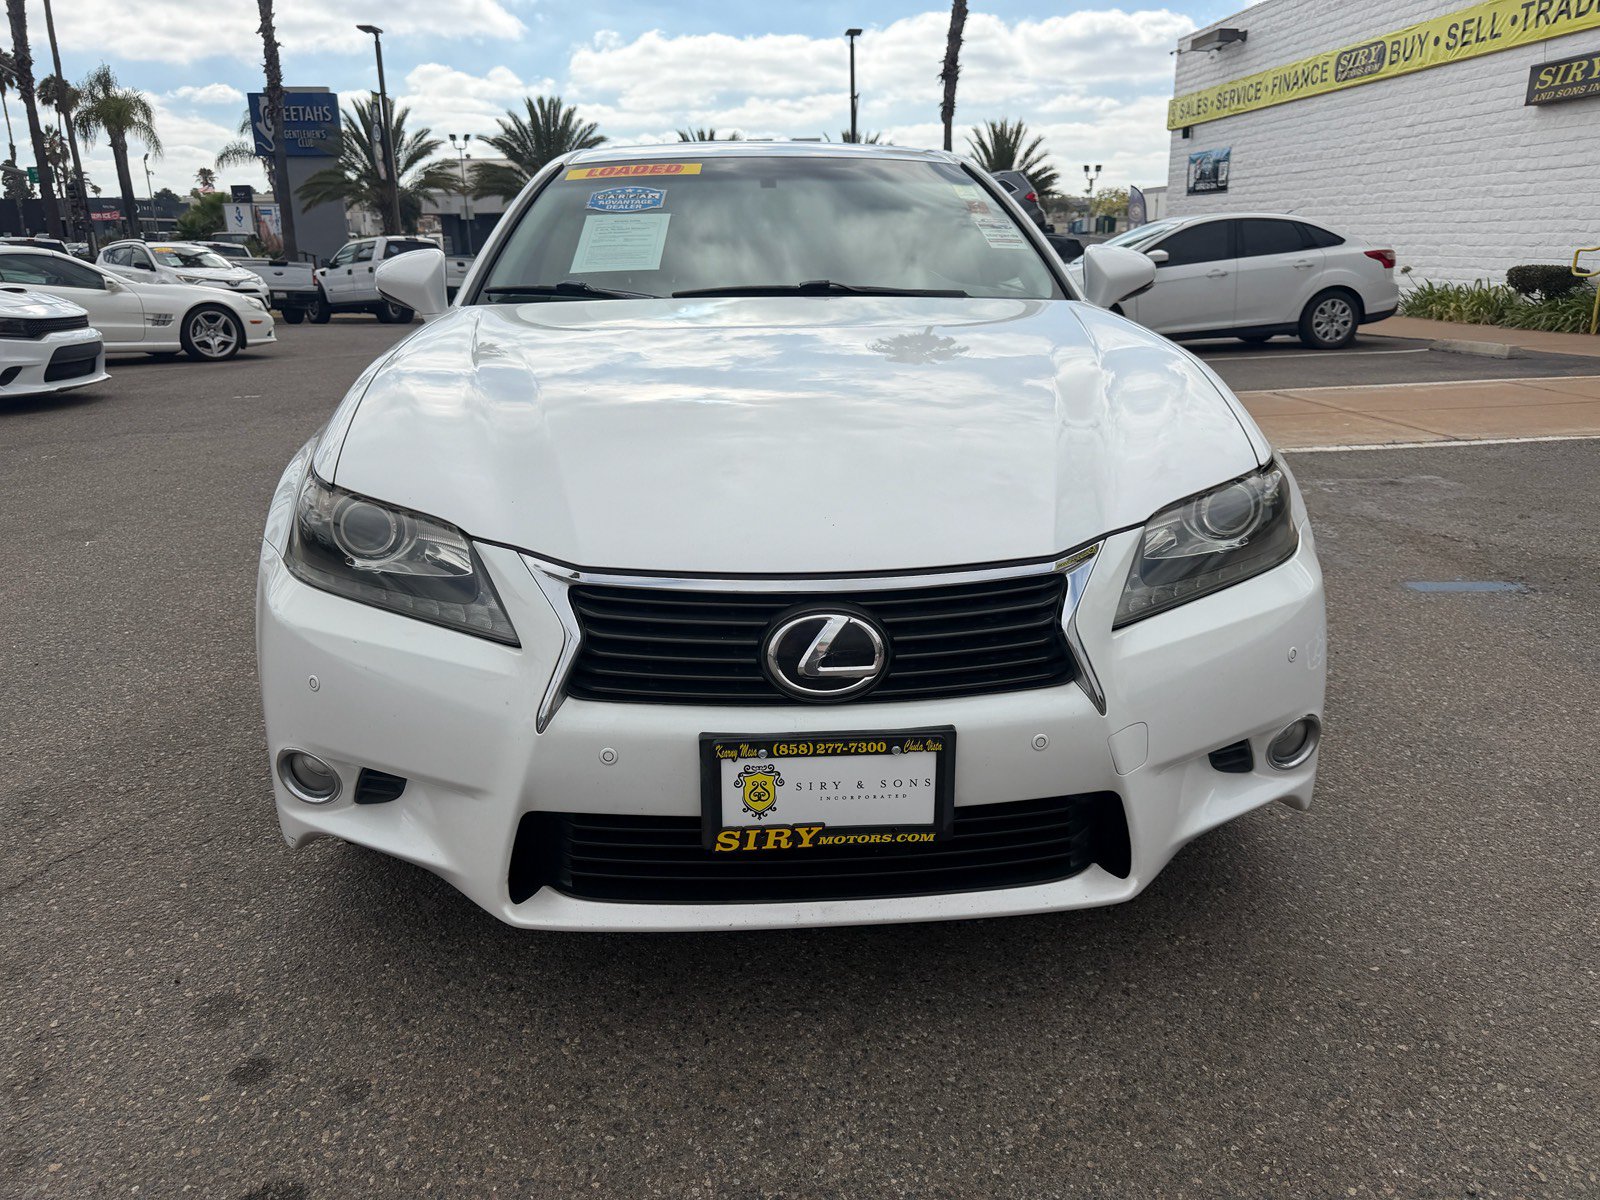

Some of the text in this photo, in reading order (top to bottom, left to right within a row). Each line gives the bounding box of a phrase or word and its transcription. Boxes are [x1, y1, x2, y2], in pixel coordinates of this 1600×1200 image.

[1389, 0, 1600, 66] BUY SELL TRAD
[1338, 43, 1384, 71] SIRY
[1180, 96, 1209, 120] SALES
[1216, 81, 1262, 110] SERVICE
[1271, 61, 1329, 96] FINANCE
[1531, 90, 1555, 102] AND
[1556, 86, 1586, 97] SONS
[586, 164, 684, 177] LOADED
[597, 192, 660, 200] CARFAX
[715, 739, 943, 760] Kearny Mesa (858) 277-7300 Chula Vista
[795, 778, 932, 792] SIRY & SONS
[819, 793, 908, 802] INCORPORATED
